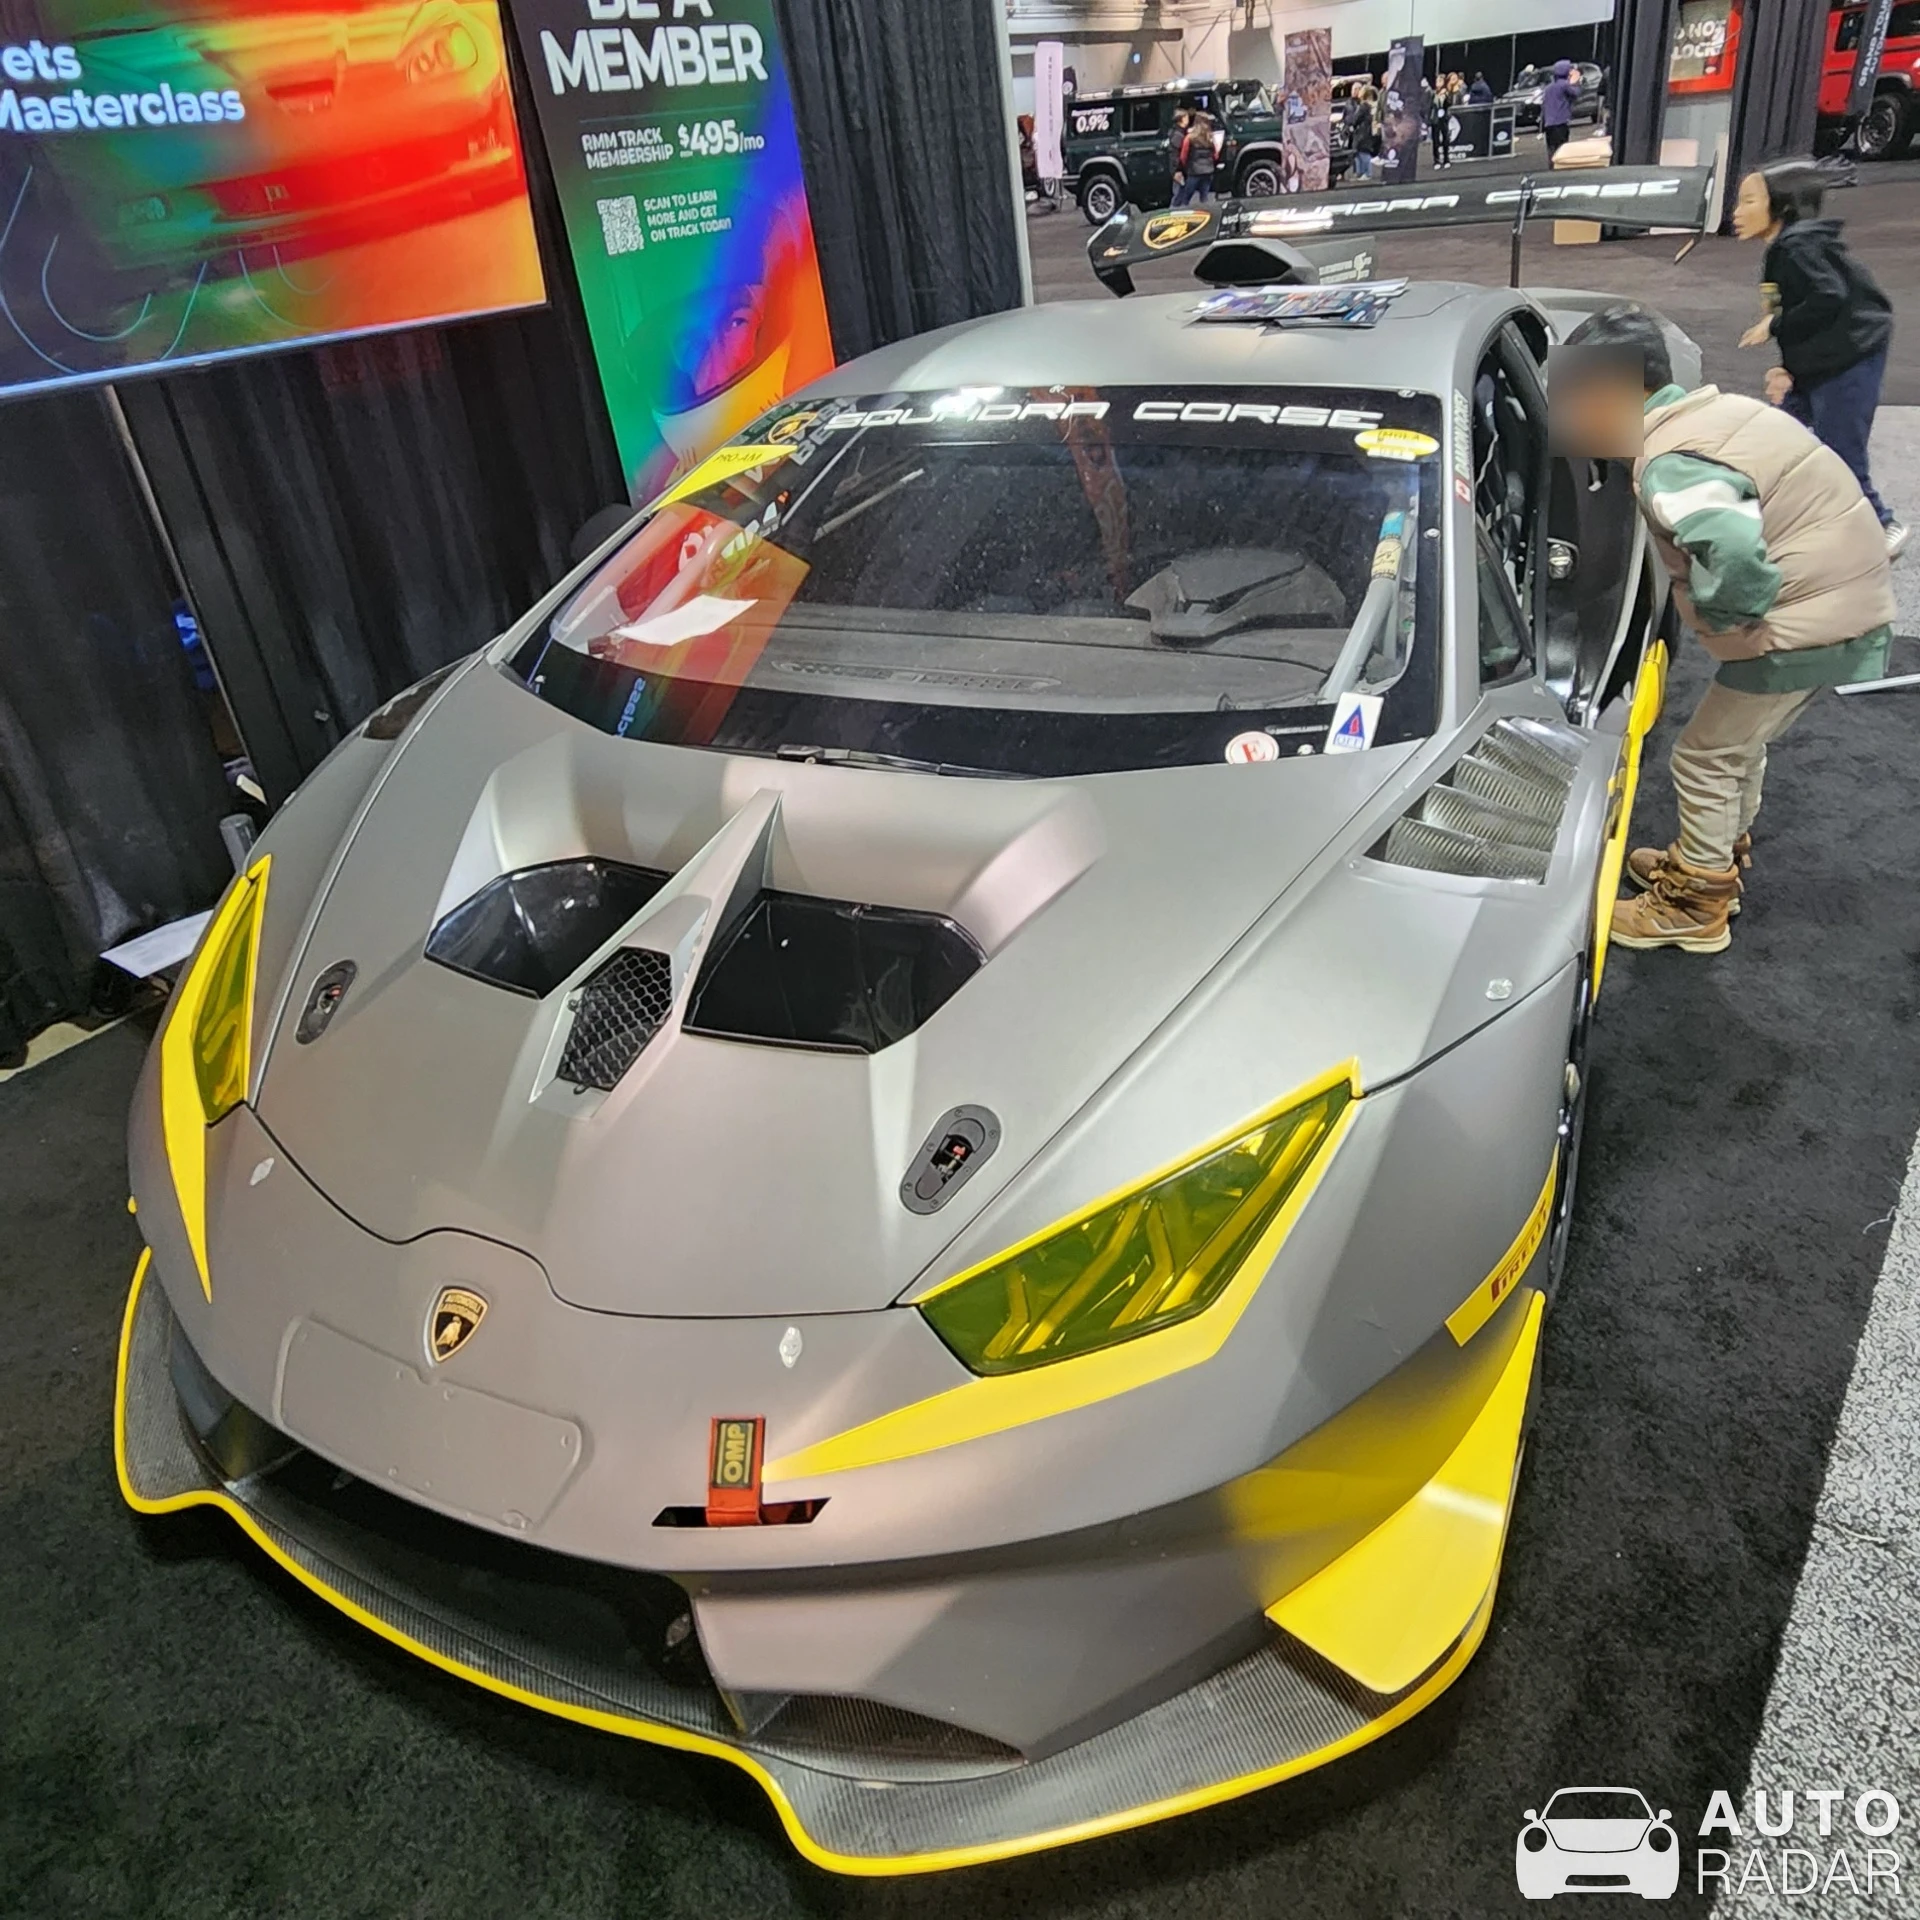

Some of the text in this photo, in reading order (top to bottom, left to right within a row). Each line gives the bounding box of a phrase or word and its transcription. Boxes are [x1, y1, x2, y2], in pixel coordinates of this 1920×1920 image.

[2, 39, 82, 80] ets
[540, 24, 769, 95] MEMBER
[1671, 42, 1722, 60] LOCK
[1859, 36, 1878, 87] GRAND
[0, 83, 245, 131] Masterclass
[1076, 114, 1110, 133] 0.9%
[582, 127, 663, 152] RMM TRACK
[586, 143, 674, 170] MEMBERSHIP
[643, 189, 717, 212] SCAN TO LEARN
[647, 204, 717, 227] MORE AND GET
[1222, 179, 1681, 226] UADRA CORSE
[650, 228, 666, 242] ON
[668, 222, 699, 239] TRACK
[824, 401, 1110, 431] SQUADRA
[1133, 401, 1384, 430] CORSE
[1491, 1199, 1548, 1303] PIRELLI
[723, 1423, 746, 1483] OMP
